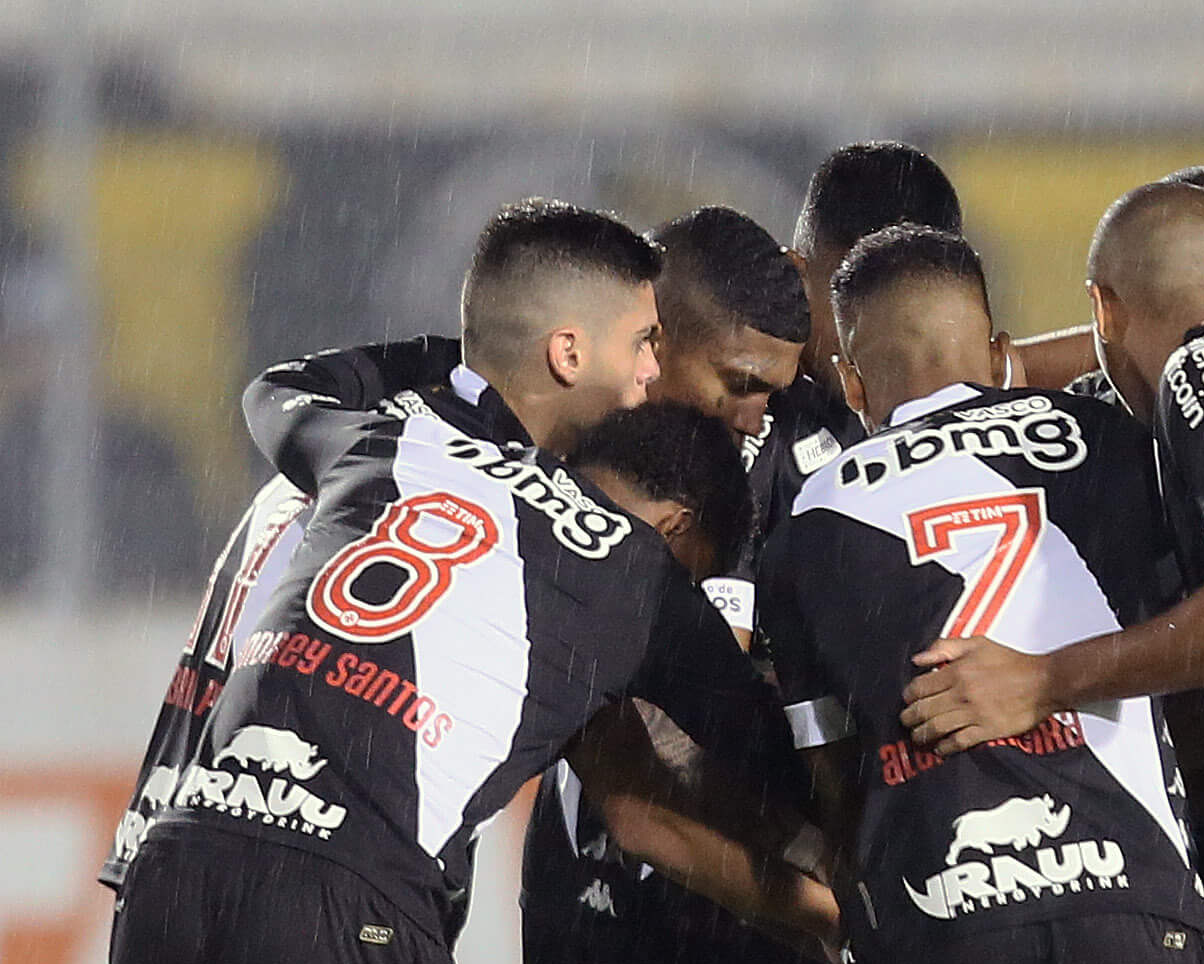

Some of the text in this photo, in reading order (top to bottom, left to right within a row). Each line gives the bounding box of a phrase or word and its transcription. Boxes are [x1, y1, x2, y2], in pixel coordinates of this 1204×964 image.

[893, 417, 1082, 470] bmg
[956, 396, 1049, 420] VASCO
[474, 440, 630, 558] bmg
[306, 491, 503, 644] 8
[903, 488, 1045, 645] 7
